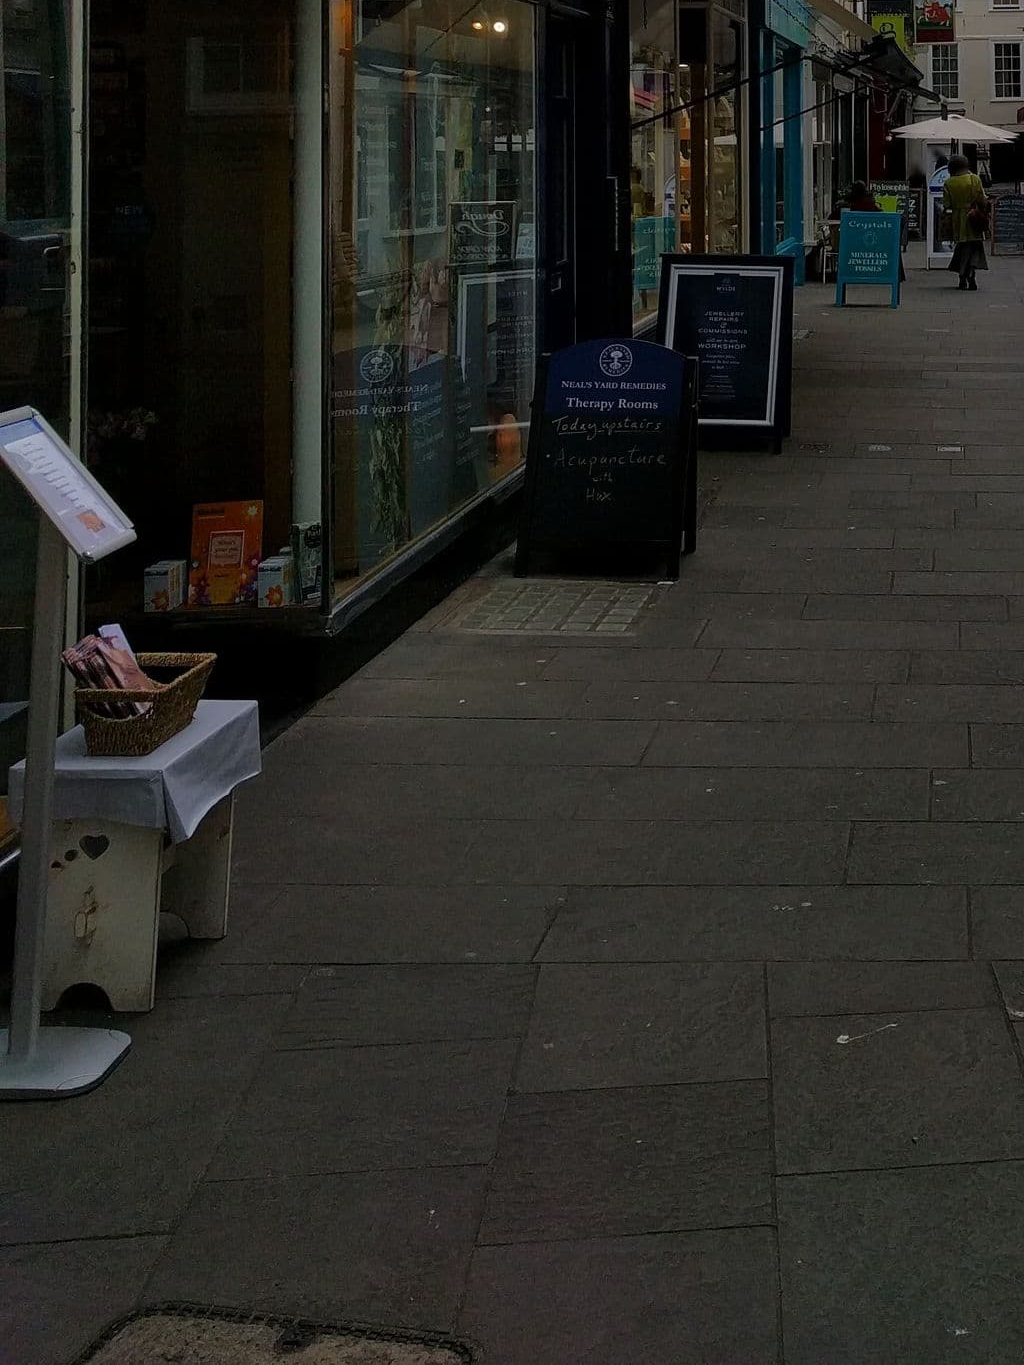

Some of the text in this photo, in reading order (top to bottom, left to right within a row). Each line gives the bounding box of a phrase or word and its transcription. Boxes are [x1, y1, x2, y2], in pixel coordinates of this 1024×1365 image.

[850, 251, 888, 259] MINERALS
[561, 380, 667, 391] NEAL'S YARD REMEDIES
[565, 396, 659, 411] Therapy Rooms
[551, 415, 662, 441] Today upstairs
[554, 444, 667, 475] Acupuncture
